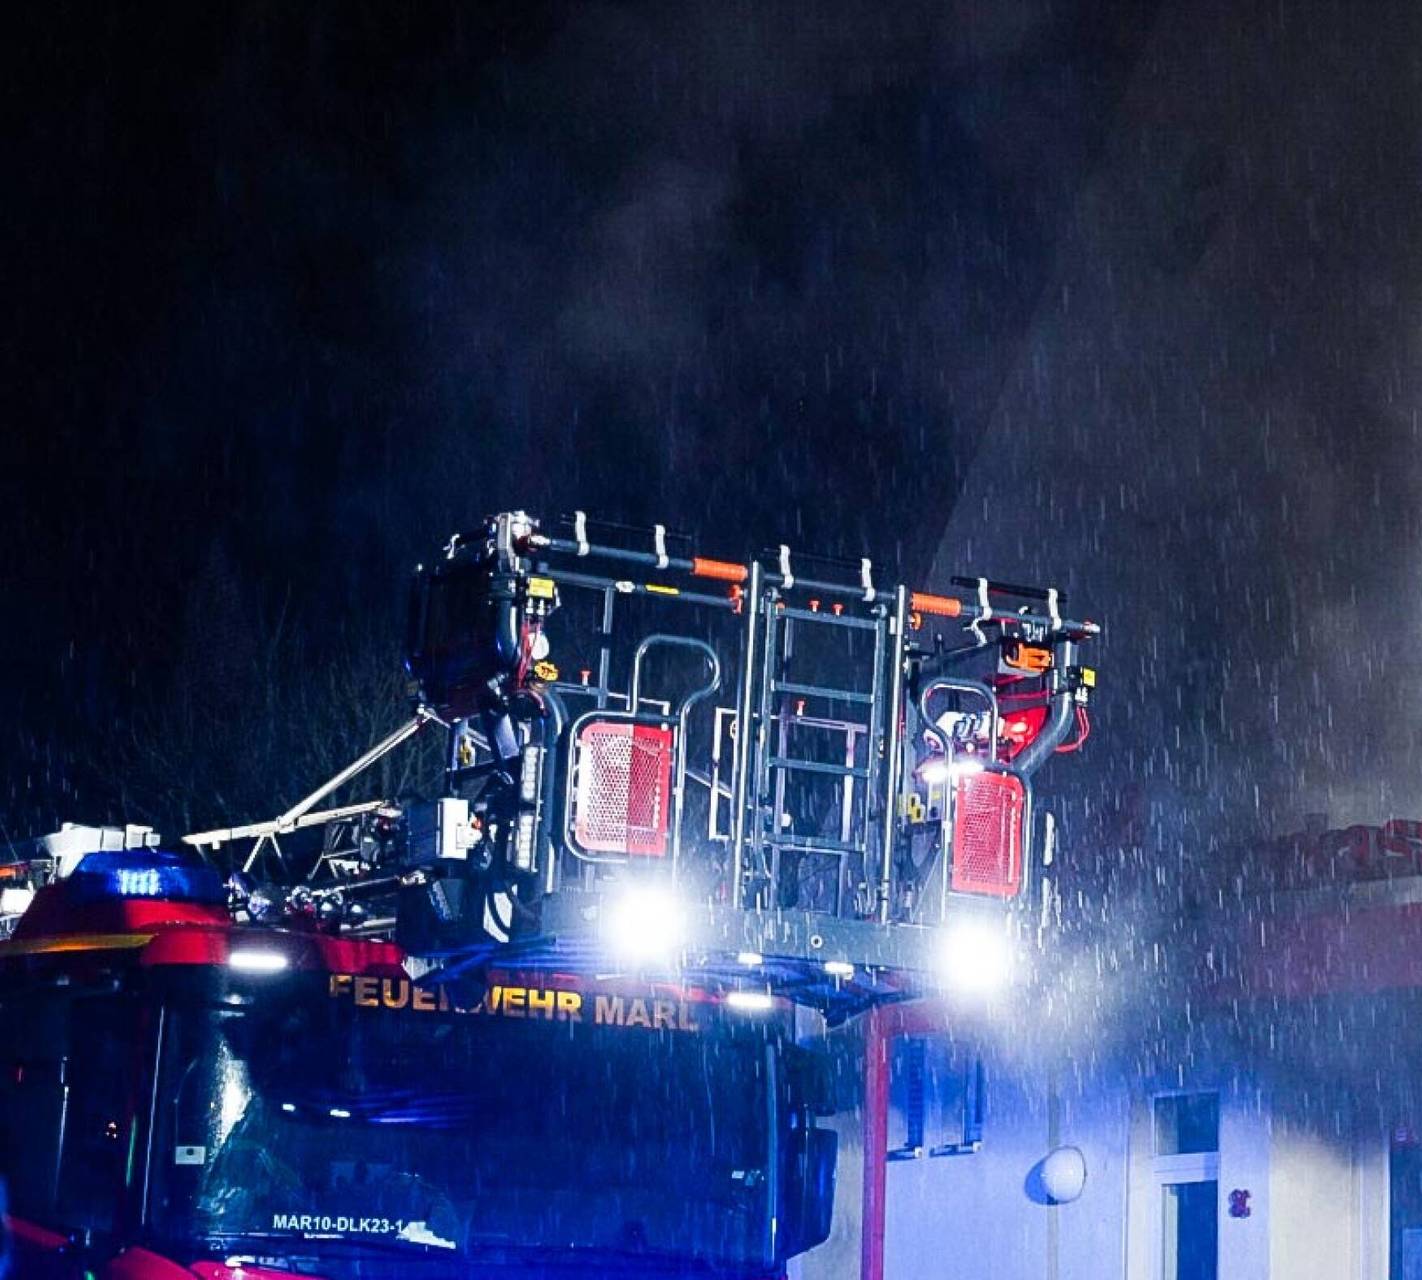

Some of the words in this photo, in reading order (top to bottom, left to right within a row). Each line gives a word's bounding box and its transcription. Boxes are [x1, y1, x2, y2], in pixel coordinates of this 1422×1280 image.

[328, 974, 583, 1022] FEUEEHR
[595, 996, 699, 1031] MARL
[273, 1214, 404, 1233] MAR10-DLK23-1
